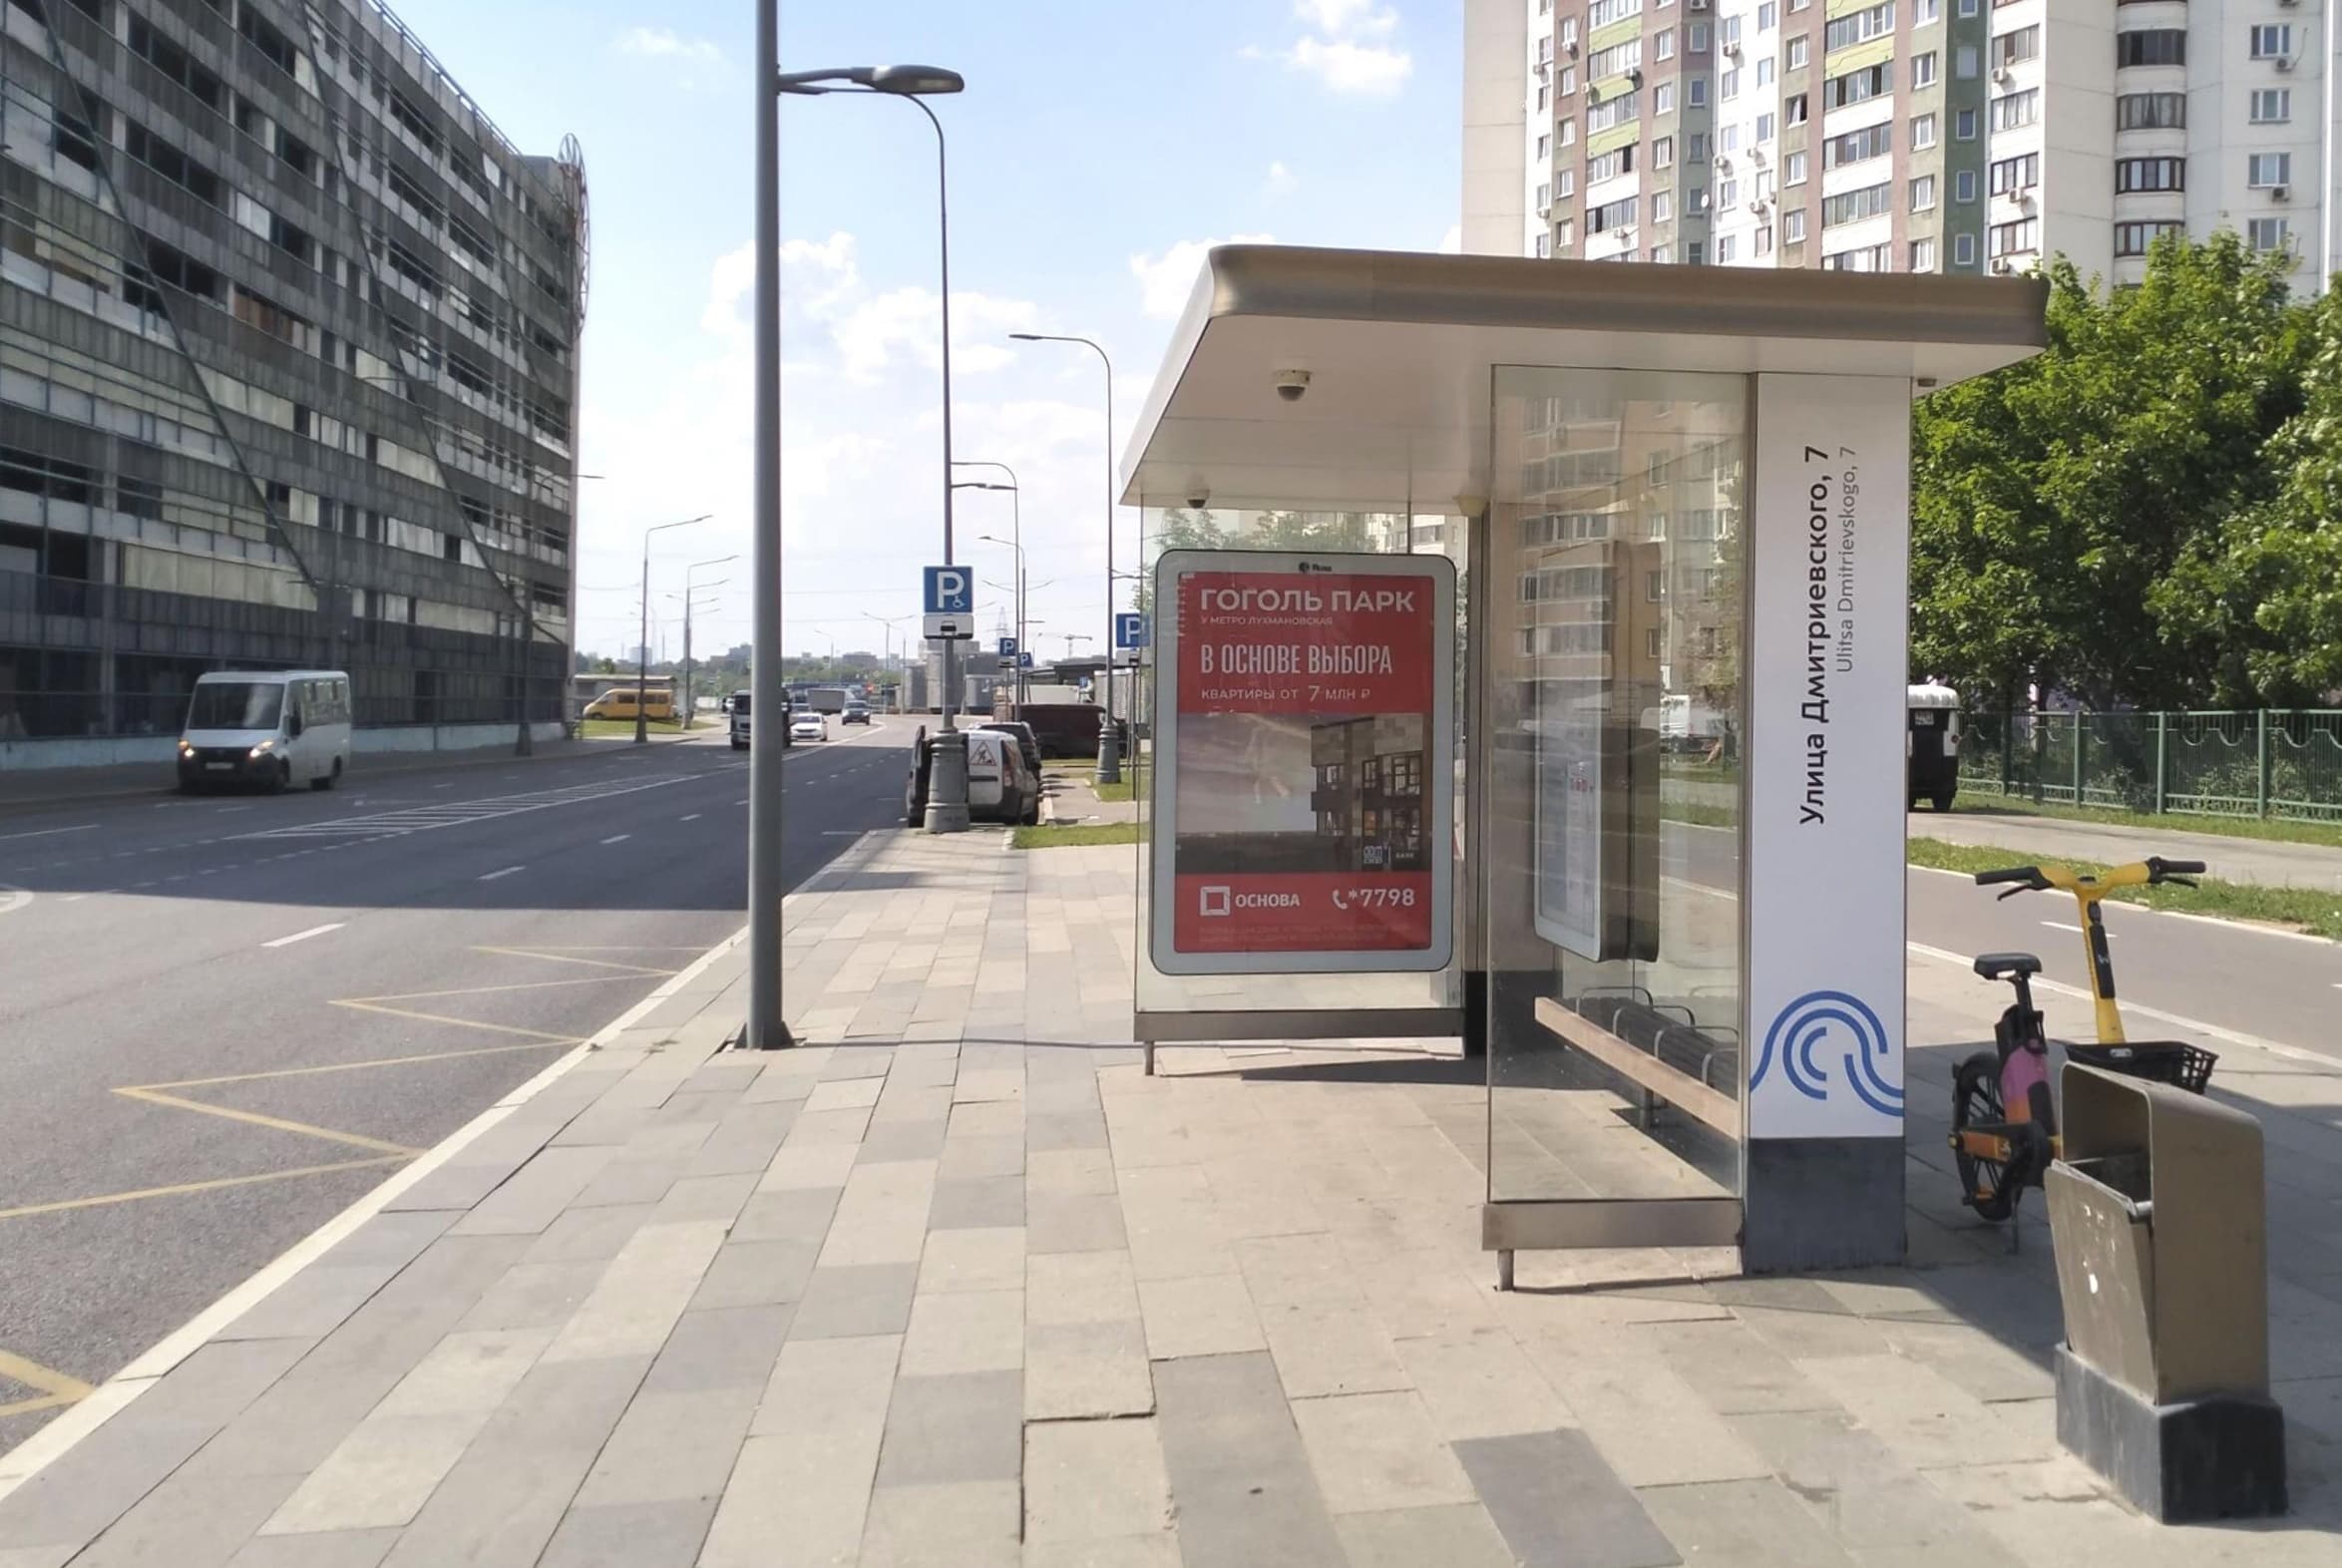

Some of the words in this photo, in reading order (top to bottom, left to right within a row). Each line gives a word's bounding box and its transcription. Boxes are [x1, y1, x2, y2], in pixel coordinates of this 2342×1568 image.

[1804, 446, 1829, 463] 7
[1839, 447, 1856, 458] 7
[1837, 466, 1859, 612] Dmitrievskogo,
[937, 572, 965, 608] P
[1201, 588, 1323, 611] ГОГОЛЬ
[1332, 590, 1414, 612] ПАРК
[1801, 474, 1833, 723] Дмитриевского,
[1201, 615, 1208, 624] У
[1210, 616, 1246, 625] МЕТРО
[1249, 615, 1333, 625] ЛУХМАНОВСКАЯ
[1836, 618, 1853, 672] Ulitsa
[1201, 645, 1214, 673] В
[1221, 644, 1301, 674] ОСНОВЕ
[1308, 645, 1392, 674] ВЫБОРА
[1201, 688, 1275, 700] КВАРТИРЫ
[1280, 688, 1298, 699] ОТ
[1308, 685, 1320, 702] 7
[1325, 689, 1356, 700] МЛН
[1799, 732, 1827, 825] Улица
[1235, 894, 1301, 909] ОСНОВА
